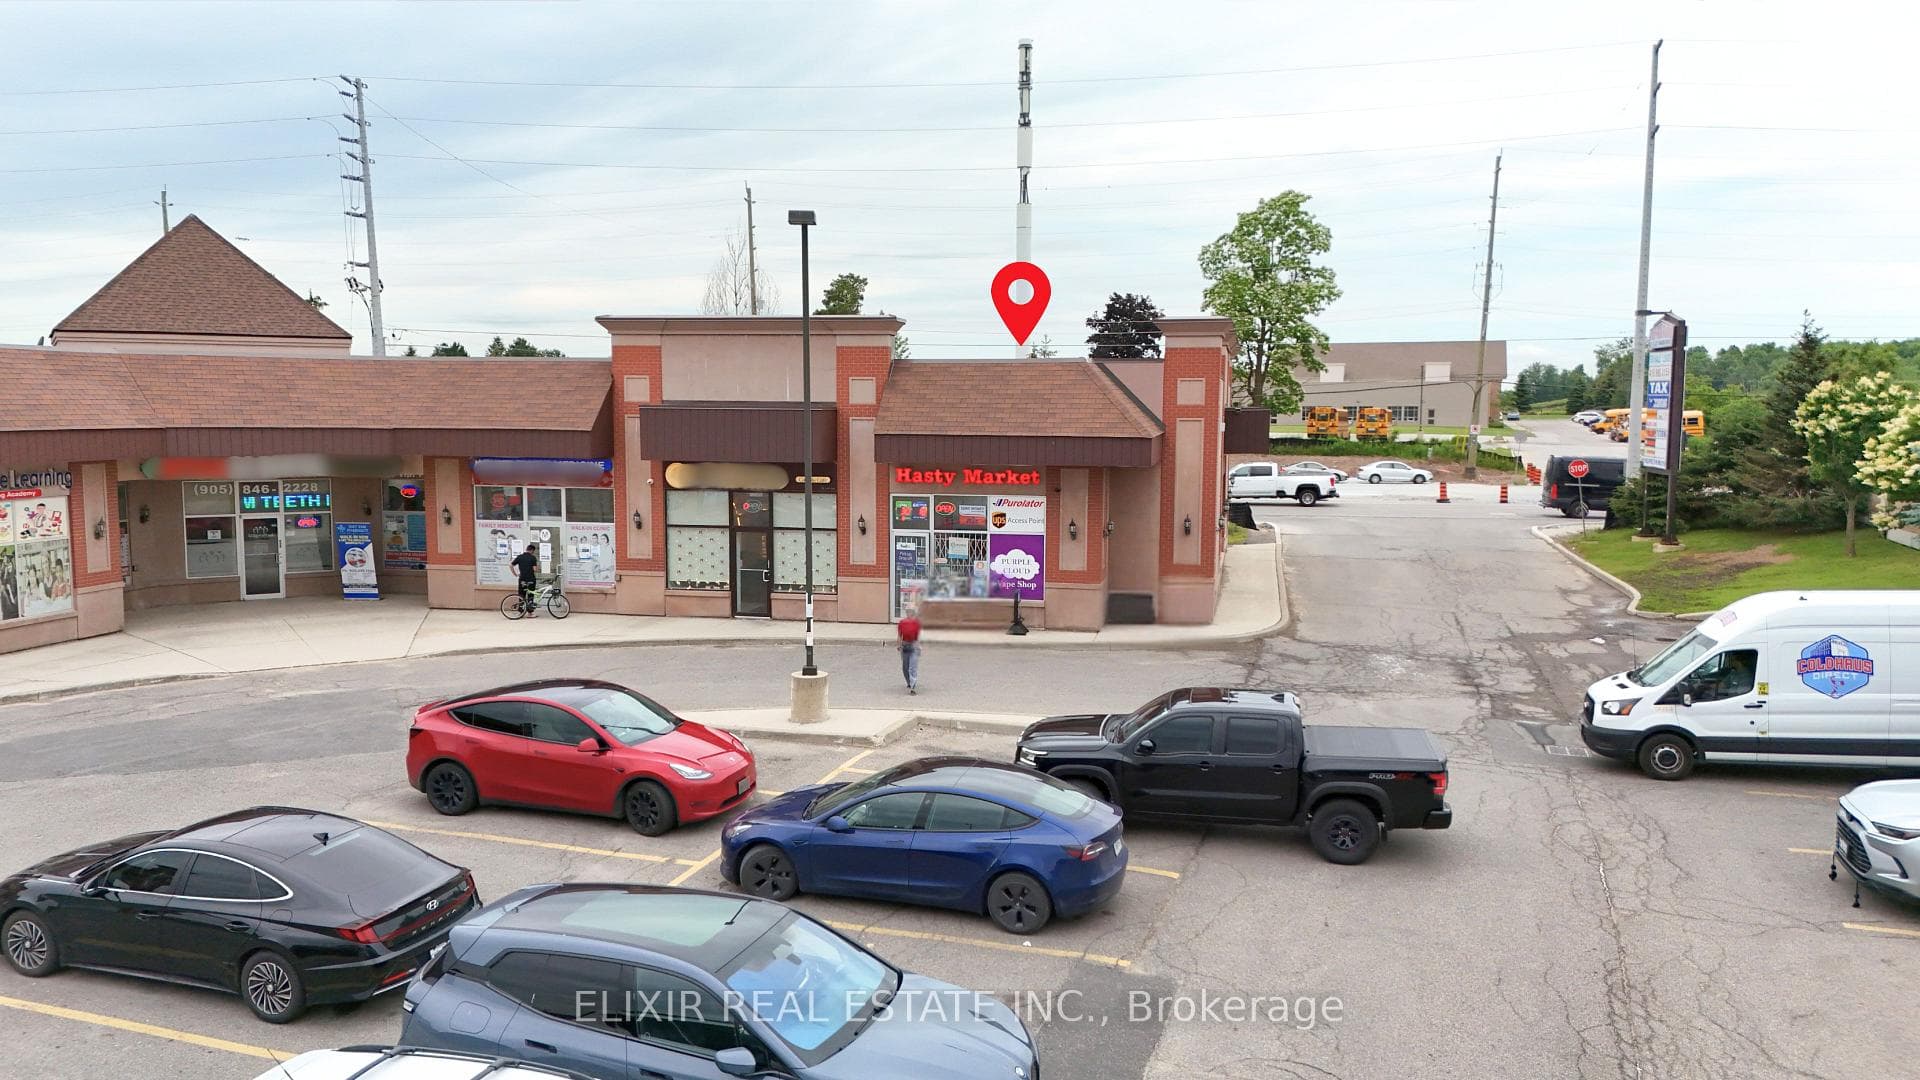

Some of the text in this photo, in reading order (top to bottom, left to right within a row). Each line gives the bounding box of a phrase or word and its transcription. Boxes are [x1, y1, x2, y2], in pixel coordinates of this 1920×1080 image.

[1650, 381, 1668, 394] TAX
[1570, 464, 1587, 473] STOP
[14, 469, 72, 489] Learning
[896, 467, 1041, 488] Hasty Market
[7, 490, 36, 498] Academy
[194, 484, 233, 496] (905)
[261, 495, 320, 509] TEETH
[1002, 498, 1045, 508] Purolator
[937, 503, 955, 513] OPEN
[993, 515, 1007, 527] ups
[1001, 558, 1032, 566] PURPLE
[1003, 567, 1031, 575] CLOUD
[1017, 580, 1037, 590] Shop
[1797, 657, 1873, 674] COLDHAUS
[1813, 671, 1859, 680] DIRECT
